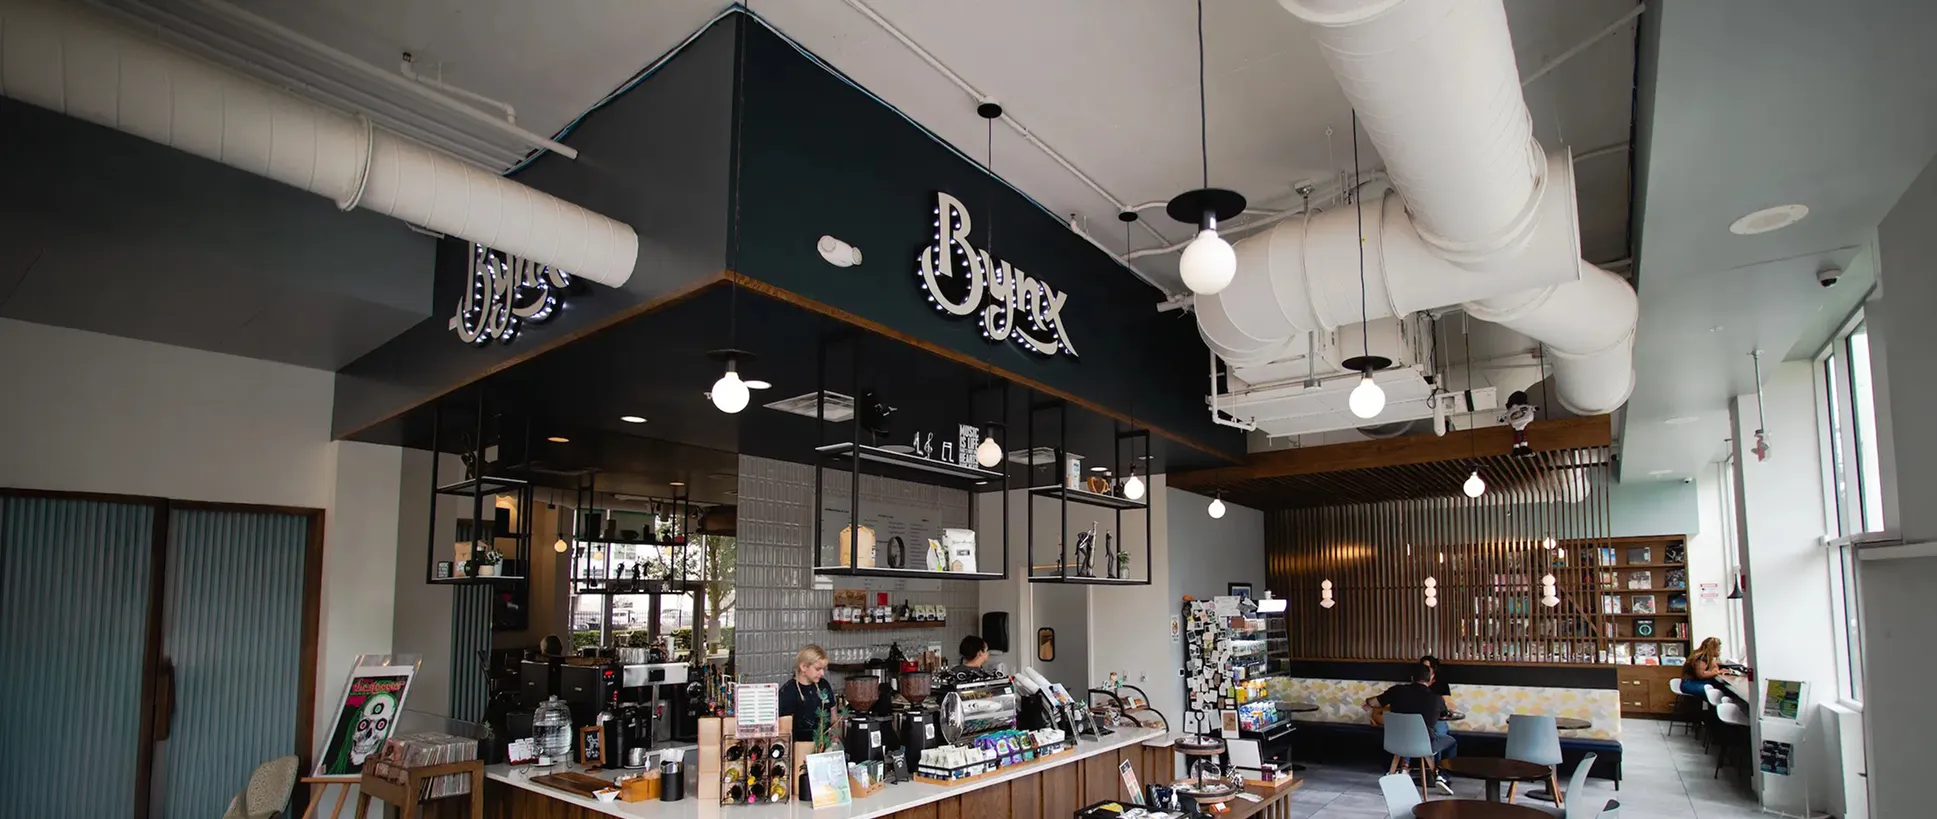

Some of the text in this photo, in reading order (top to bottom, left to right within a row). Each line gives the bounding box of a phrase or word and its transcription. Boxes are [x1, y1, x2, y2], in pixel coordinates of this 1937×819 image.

[921, 191, 1079, 357] Bynx
[959, 424, 980, 438] MUSIC
[959, 436, 967, 449] IS
